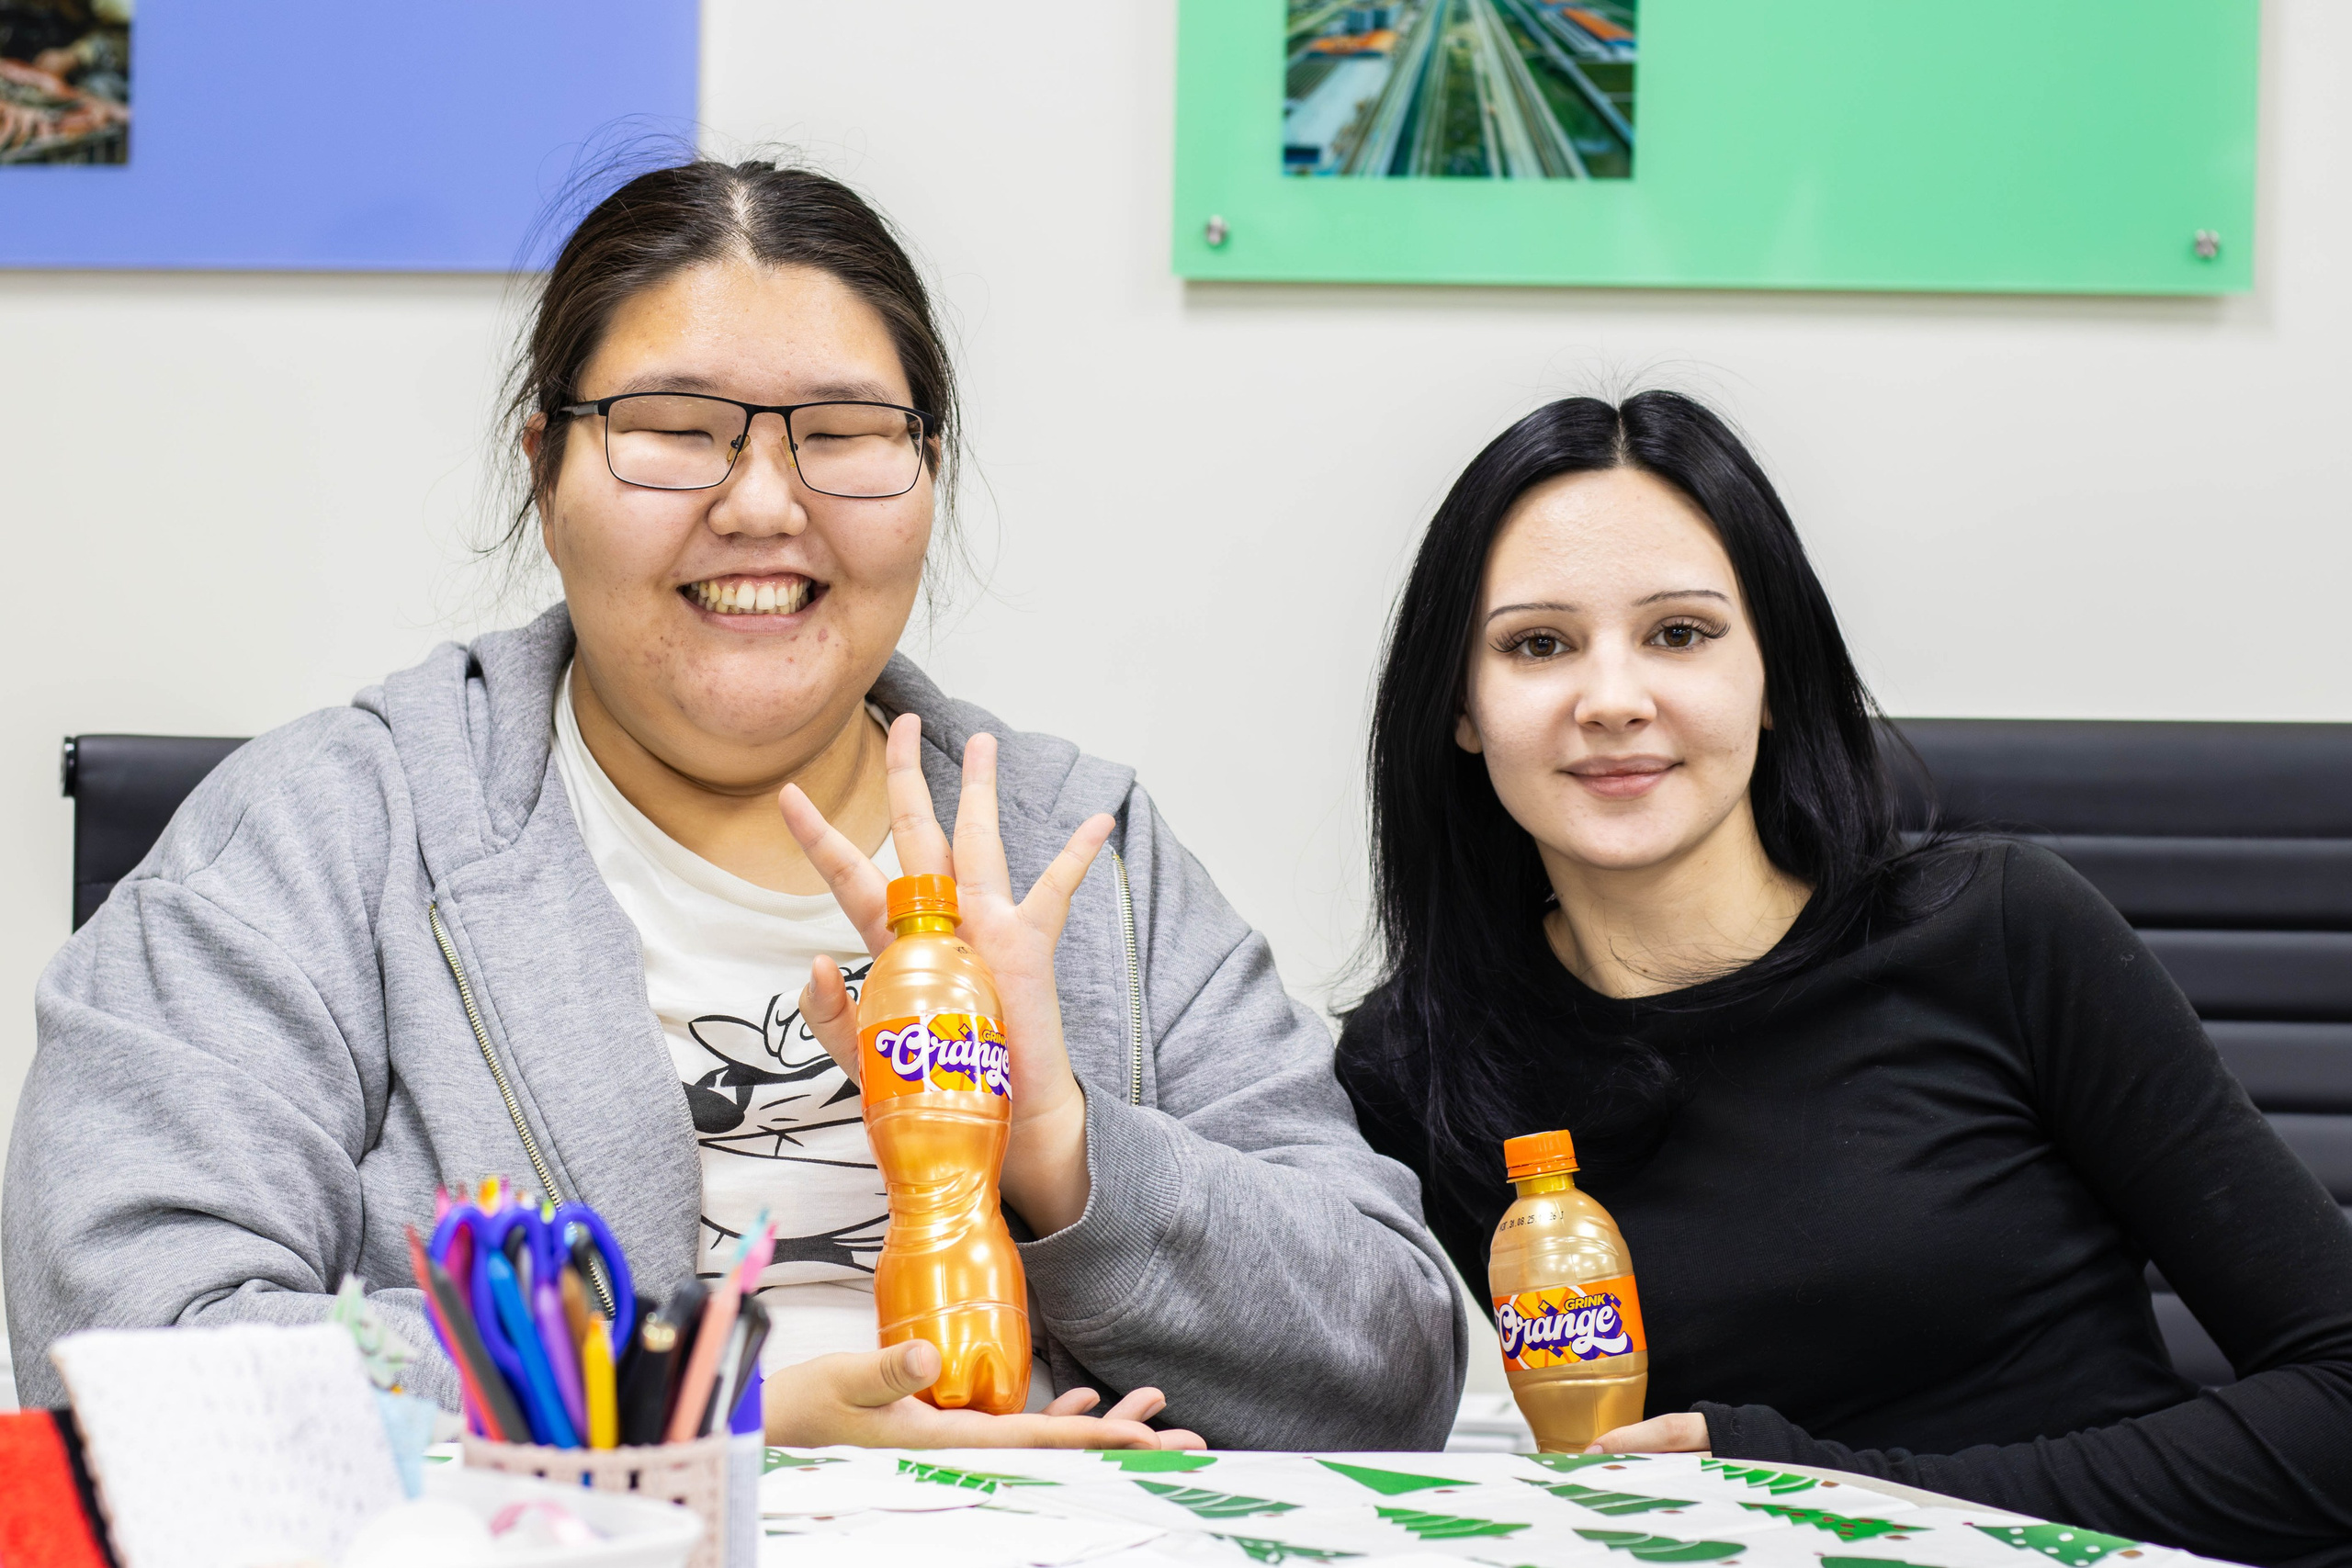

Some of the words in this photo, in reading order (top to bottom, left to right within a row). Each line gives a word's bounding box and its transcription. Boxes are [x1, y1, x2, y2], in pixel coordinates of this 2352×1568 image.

[876, 1023, 1012, 1100] Orange
[1566, 1294, 1606, 1311] GRINK
[1494, 1303, 1628, 1354] Orange
